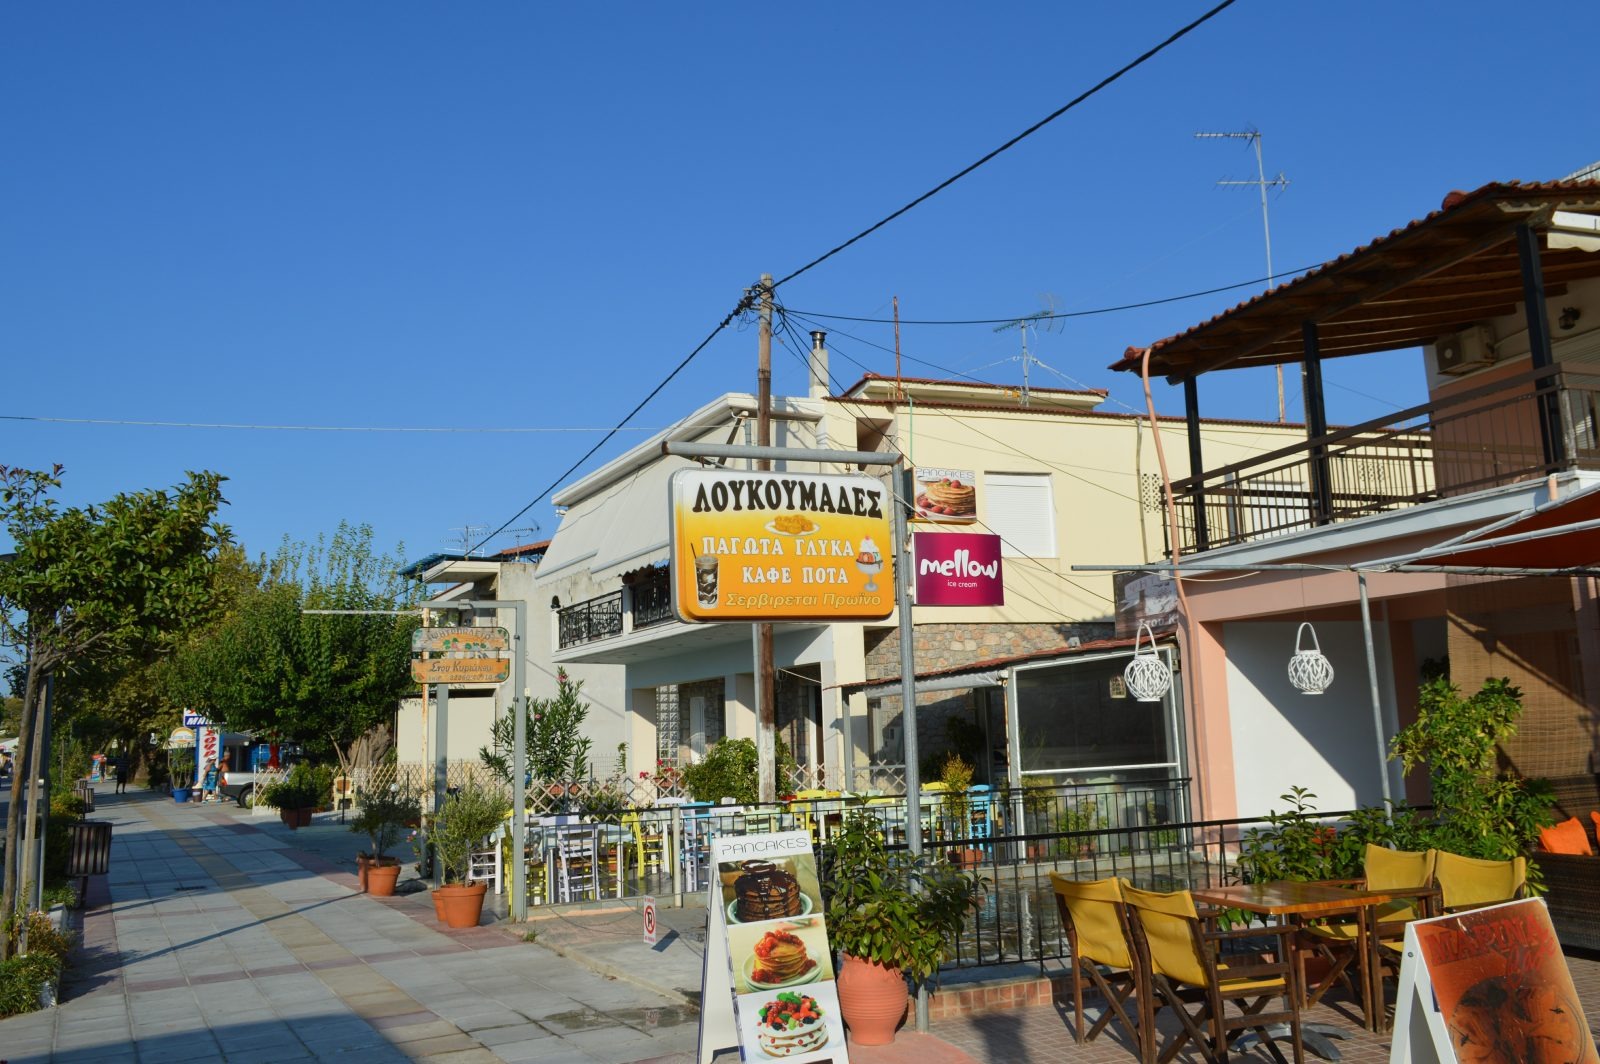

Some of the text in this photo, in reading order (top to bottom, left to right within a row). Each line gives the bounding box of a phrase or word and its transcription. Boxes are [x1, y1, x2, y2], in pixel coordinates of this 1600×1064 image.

[915, 468, 975, 479] PANCAKES
[692, 479, 883, 520] ΛΟΥΚΟΥΜΑΔΕΣ
[702, 536, 854, 557] ΠΑΓΩΤΑ ΓΛΥΚΑ
[920, 549, 998, 579] mellow
[742, 566, 848, 584] ΚΑΦΕ ΠΟΤΑ
[947, 580, 957, 588] ice
[725, 593, 818, 609] Σερβιρεται
[722, 838, 808, 855] PANCAKES
